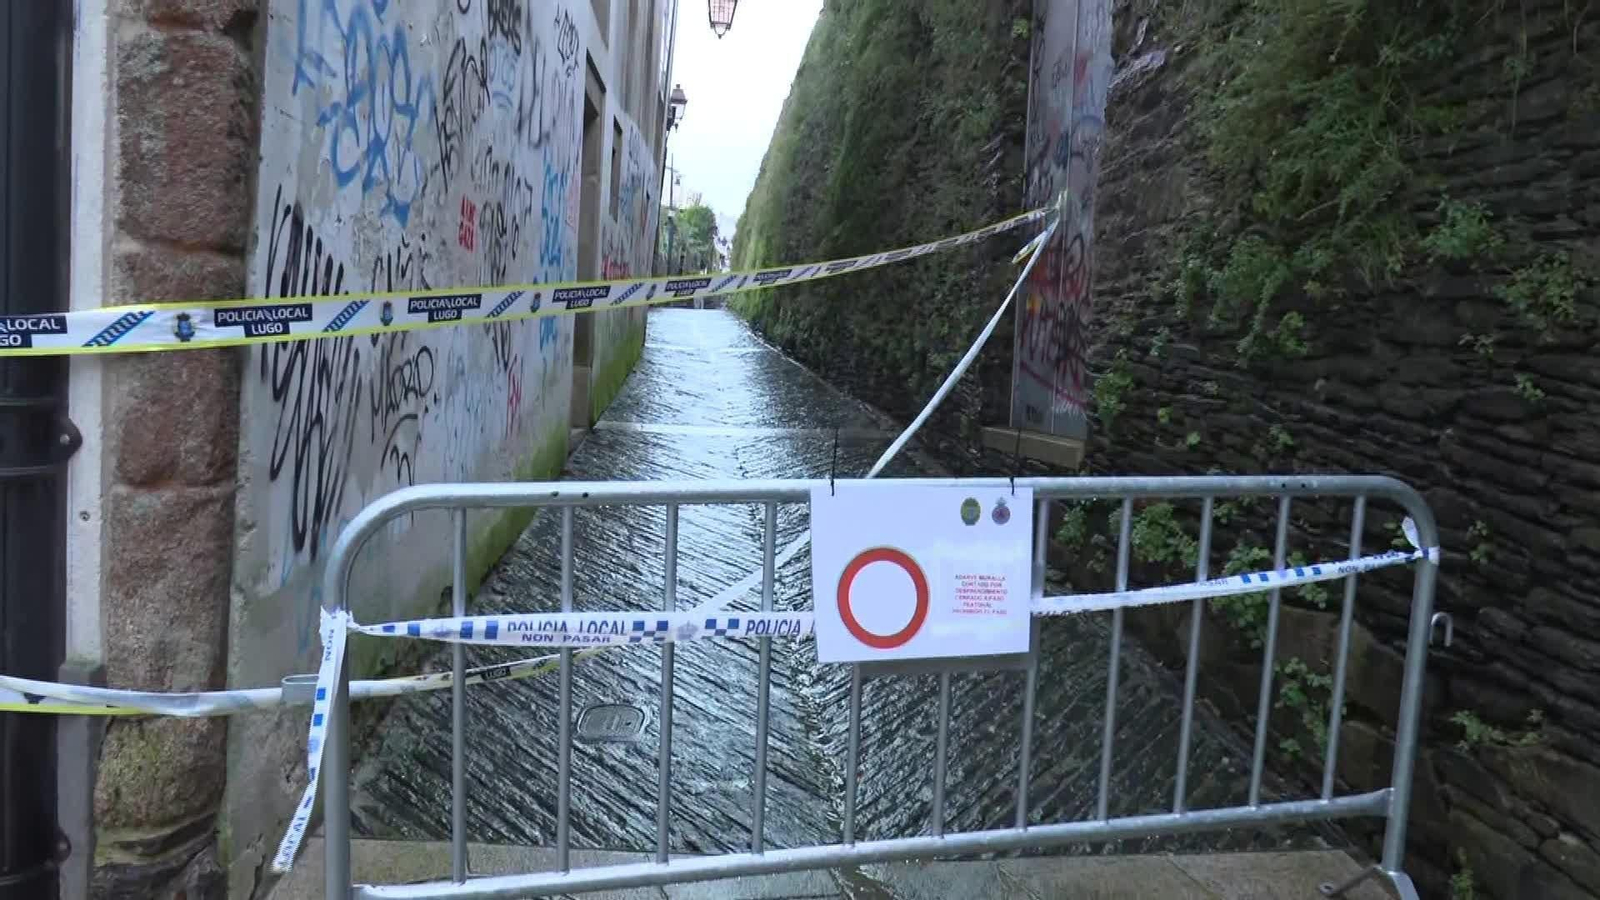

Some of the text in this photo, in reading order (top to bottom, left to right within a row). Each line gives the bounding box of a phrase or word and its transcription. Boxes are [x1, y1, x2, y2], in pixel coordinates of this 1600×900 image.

[554, 287, 607, 300] POLICIA LOCAL
[410, 296, 479, 311] POLICIA LOCAL
[217, 307, 309, 323] POLICIA LOCAL
[433, 309, 459, 321] LUGO
[6, 318, 61, 332] LOCAL
[252, 322, 284, 334] LUGO
[745, 619, 801, 636] POLICIA
[521, 633, 611, 643] NON PASAR
